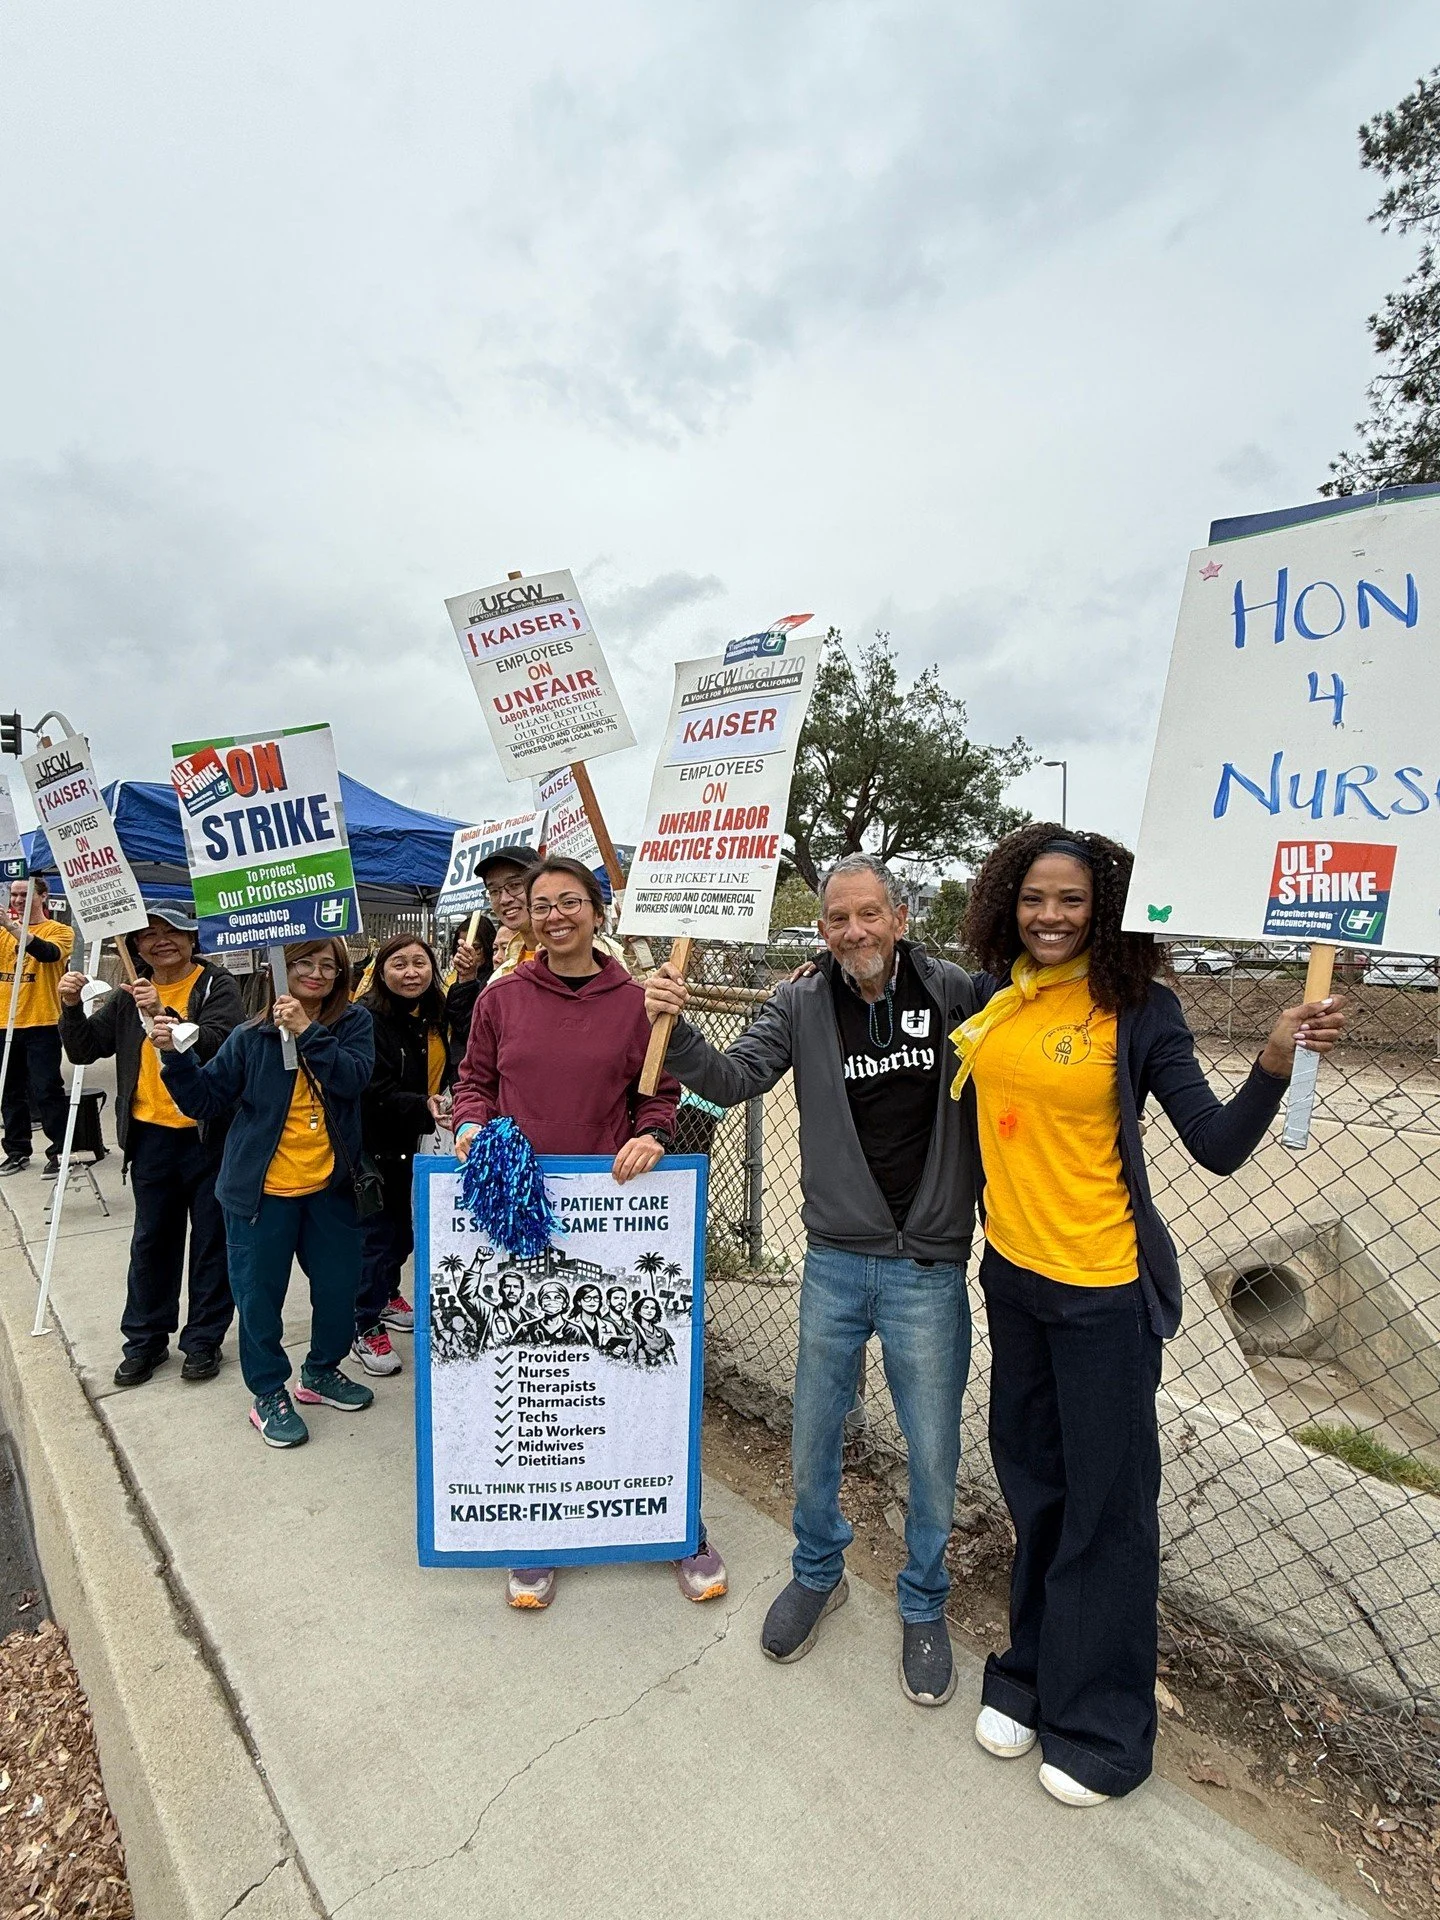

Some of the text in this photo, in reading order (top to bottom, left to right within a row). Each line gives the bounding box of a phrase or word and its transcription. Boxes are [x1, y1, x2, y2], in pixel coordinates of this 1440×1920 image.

[479, 583, 543, 612] UFCW
[481, 613, 567, 648] KAISER
[496, 641, 574, 674] EMPLOYEES
[528, 661, 553, 681] ON
[697, 655, 806, 692] UFCW Local 770
[493, 669, 597, 713] UNFAIR
[683, 694, 690, 703] A
[709, 690, 721, 698] FOR
[722, 682, 755, 694] WORKING
[755, 675, 799, 689] CALIFORNIA
[1307, 671, 1349, 727] 4
[499, 687, 602, 725] LABOR PRACTICE STRIKE
[513, 700, 599, 731] PLEASE RESPECT
[510, 717, 616, 752] UNITED FOOD AND COMMERCIAL
[513, 708, 606, 741] OUR PICKET LINE
[683, 708, 777, 744] KAISER
[512, 723, 618, 759] WORKERS UNION LOCAL NO. 770
[36, 750, 71, 779] UFCW
[171, 760, 195, 786] ULP
[226, 741, 287, 798] ON
[679, 758, 764, 782] EMPLOYEES
[180, 761, 223, 800] STRIKE
[44, 778, 90, 811] KAISER
[702, 781, 728, 805] ON
[482, 821, 505, 835] Labor
[504, 813, 538, 829] Practice
[558, 806, 570, 819] ON
[658, 805, 770, 836] UNFAIR LABOR
[58, 815, 99, 841] EMPLOYEES
[202, 793, 336, 862] STRIKE
[75, 835, 91, 853] ON
[638, 834, 779, 862] PRACTICE STRIKE
[63, 845, 118, 878] UNFAIR
[1280, 843, 1333, 875] ULP
[68, 864, 123, 889] LABOR PRACTICE STRIKE
[246, 862, 298, 883] To Protect
[650, 872, 750, 884] OUR PICKET LINE
[78, 878, 122, 899] PLEASE RESPECT
[80, 887, 129, 908] OUR PICKET LINE
[217, 872, 336, 910] Our Professions
[636, 891, 756, 905] UNITED FOOD AND COMMERCIAL
[1278, 871, 1378, 905] STRIKE
[635, 903, 754, 917] WORKERS UNION LOCAL NO. 770
[1270, 908, 1333, 920] #TogetherWeWin
[216, 923, 307, 946] #TogetherWeRise
[1053, 1052, 1070, 1066] 770
[560, 1197, 624, 1212] PATIENT
[628, 1195, 669, 1211] CARE
[451, 1217, 466, 1233] IS
[562, 1217, 608, 1234] SAME
[612, 1215, 669, 1232] THING
[518, 1349, 590, 1363] Providers
[518, 1366, 570, 1378] Nurses
[517, 1380, 597, 1395] Therapists
[517, 1395, 606, 1408] Pharmacists
[517, 1411, 558, 1423] Techs
[518, 1424, 606, 1437] Lab Workers
[517, 1439, 585, 1452] Midwives
[518, 1454, 586, 1467] Dietitians
[448, 1475, 674, 1495] STILL THINK THIS IS ABOUT GREED?
[586, 1496, 668, 1519] SYSTEM
